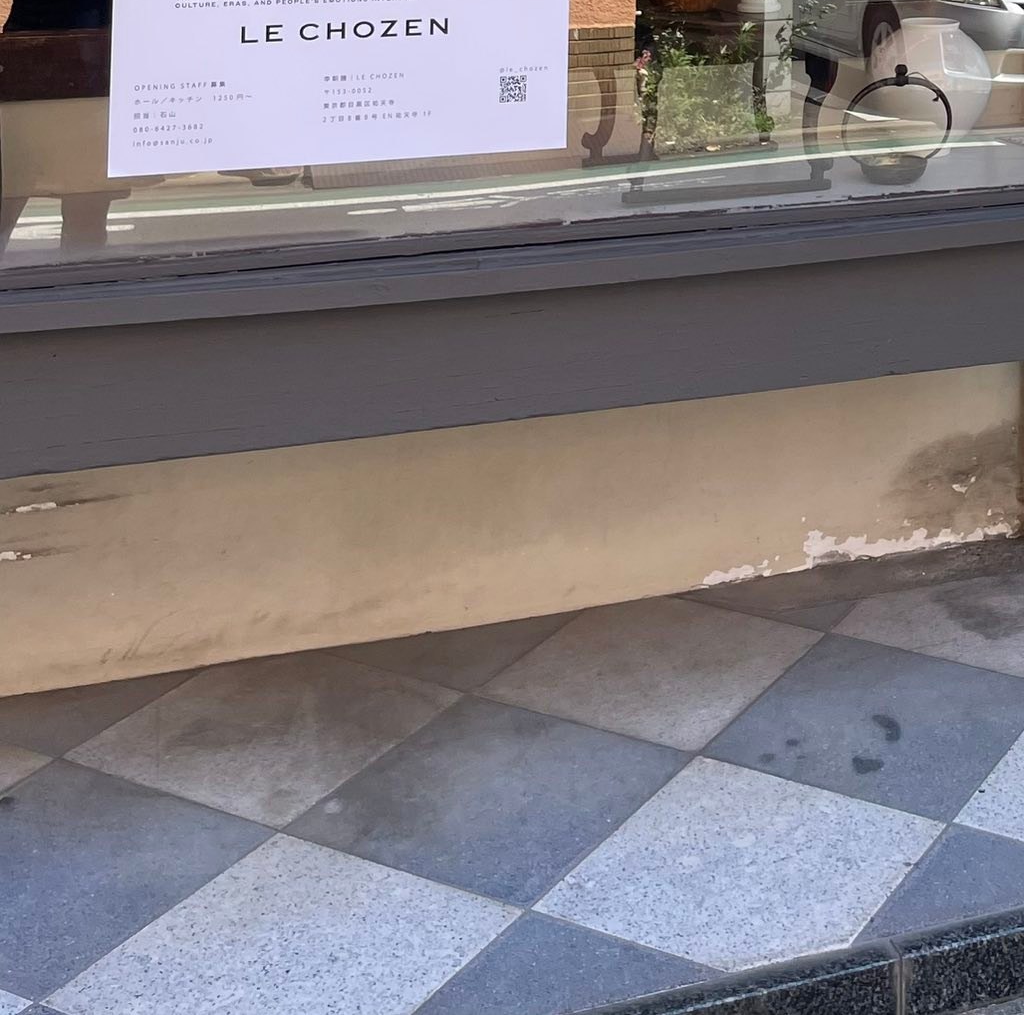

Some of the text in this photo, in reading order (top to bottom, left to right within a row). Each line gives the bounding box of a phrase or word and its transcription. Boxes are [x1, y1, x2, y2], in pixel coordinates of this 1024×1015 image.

[241, 17, 449, 44] LE CHOZEN
[370, 72, 404, 80] CHOZEN
[134, 83, 176, 91] OPENING
